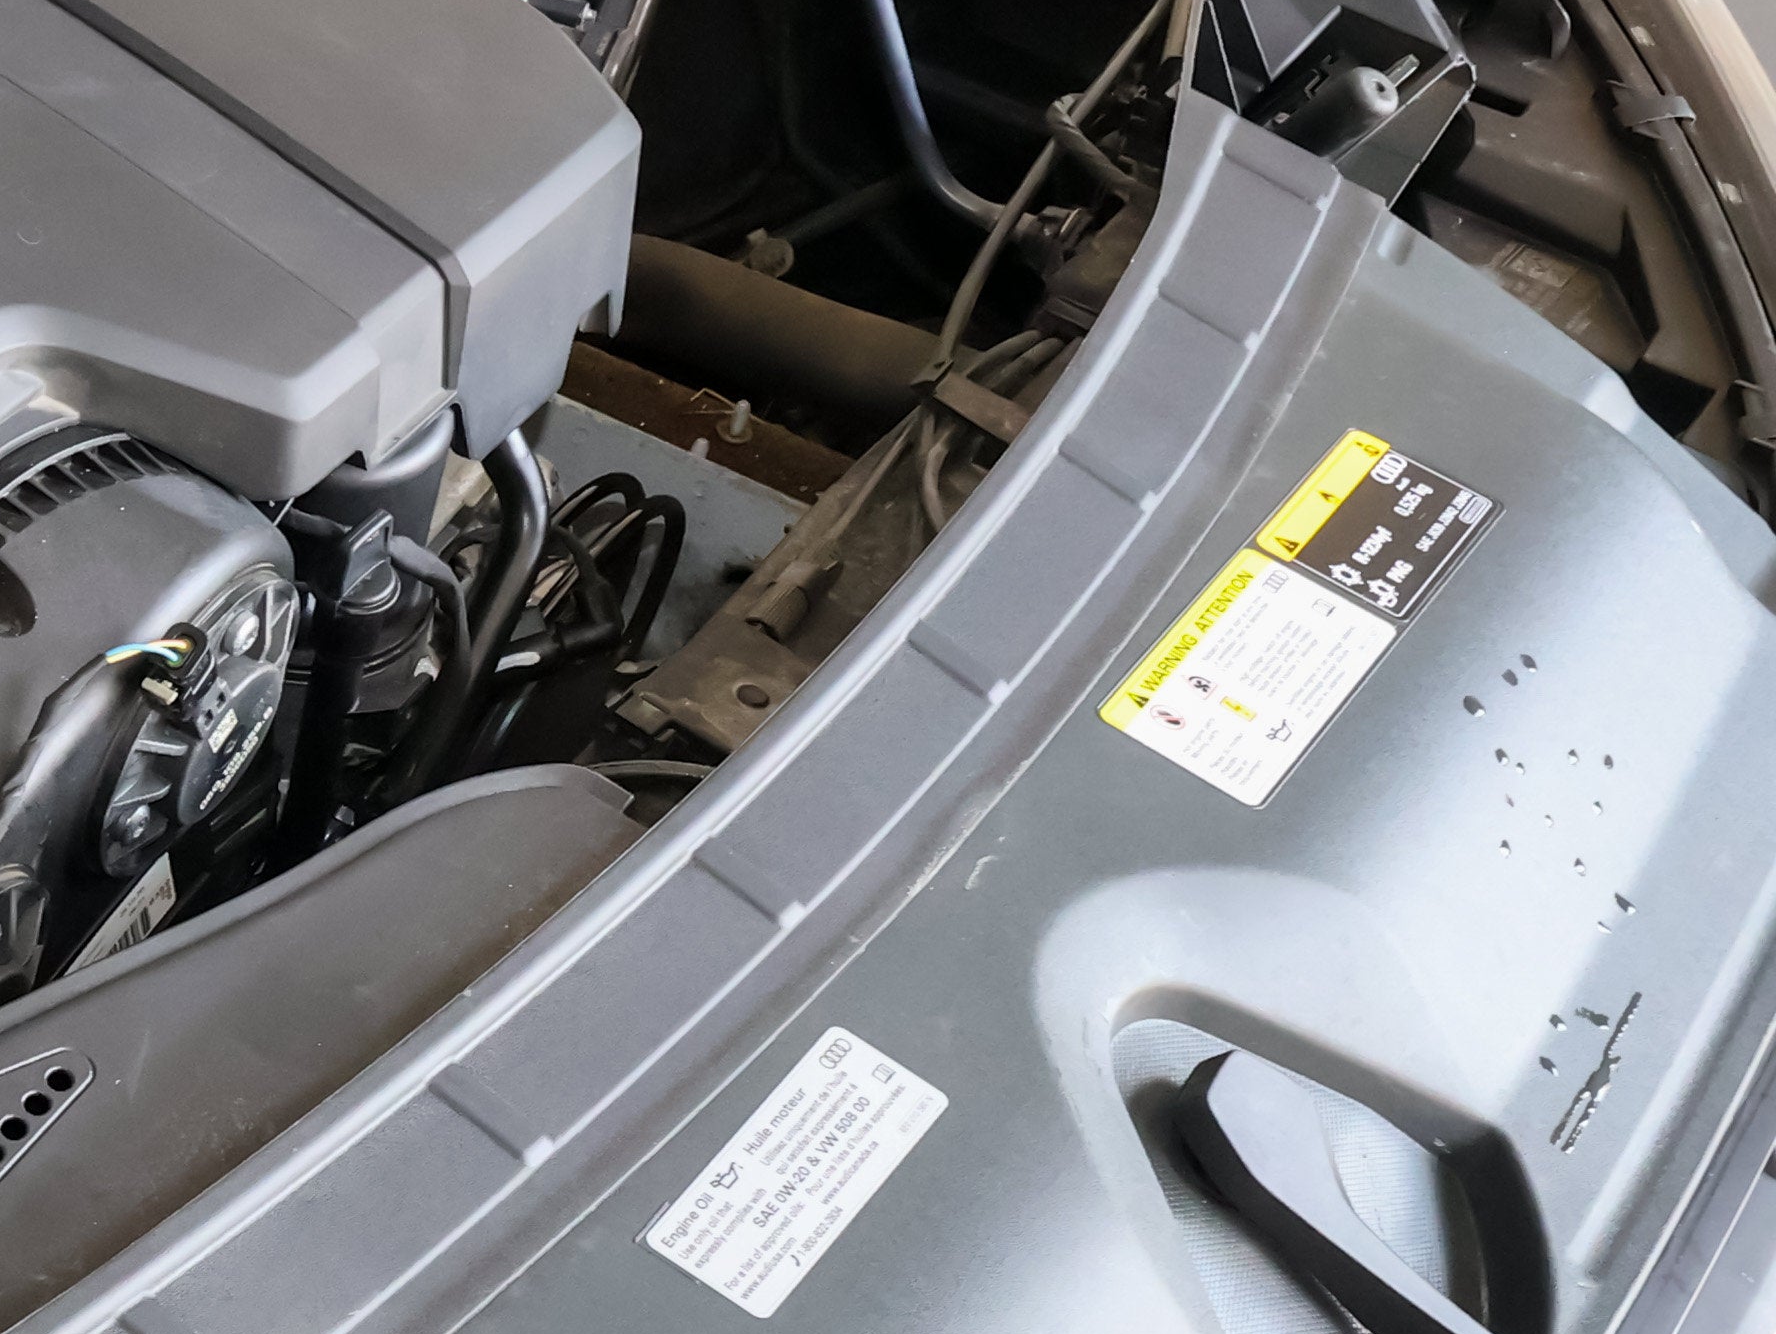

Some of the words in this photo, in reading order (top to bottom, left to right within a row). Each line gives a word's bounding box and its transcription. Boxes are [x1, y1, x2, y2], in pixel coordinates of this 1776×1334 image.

[1385, 556, 1414, 585] PAG
[1139, 631, 1199, 695] WARNING
[1192, 567, 1254, 634] ATTENTION
[742, 1124, 773, 1157] Huile
[767, 1086, 807, 1129] moteur
[781, 1096, 824, 1143] uniquement
[816, 1088, 830, 1102] de
[751, 1199, 780, 1229] SAE
[773, 1163, 812, 1204] 0W-20
[804, 1151, 821, 1168] &
[814, 1130, 840, 1157] VW
[833, 1108, 858, 1134] 508
[851, 1093, 871, 1113] 00
[773, 1159, 791, 1177] qui
[784, 1132, 813, 1164] satisfait
[804, 1175, 826, 1197] Pour
[819, 1162, 838, 1180] une
[831, 1146, 851, 1166] liste
[819, 1138, 880, 1207] www.audicanada.ca
[660, 1207, 701, 1251] Engine
[693, 1190, 714, 1212] Oil
[678, 1241, 698, 1261] Use
[691, 1224, 714, 1247] only
[705, 1213, 721, 1229] oil
[714, 1199, 734, 1218] that
[692, 1232, 729, 1271] expressly
[721, 1201, 755, 1238] complies
[748, 1185, 768, 1205] with
[723, 1274, 741, 1291] For
[740, 1255, 757, 1272] list
[750, 1247, 764, 1260] of
[757, 1214, 793, 1253] approved
[786, 1199, 806, 1219] oils:
[738, 1234, 798, 1302] www.audiusa.com
